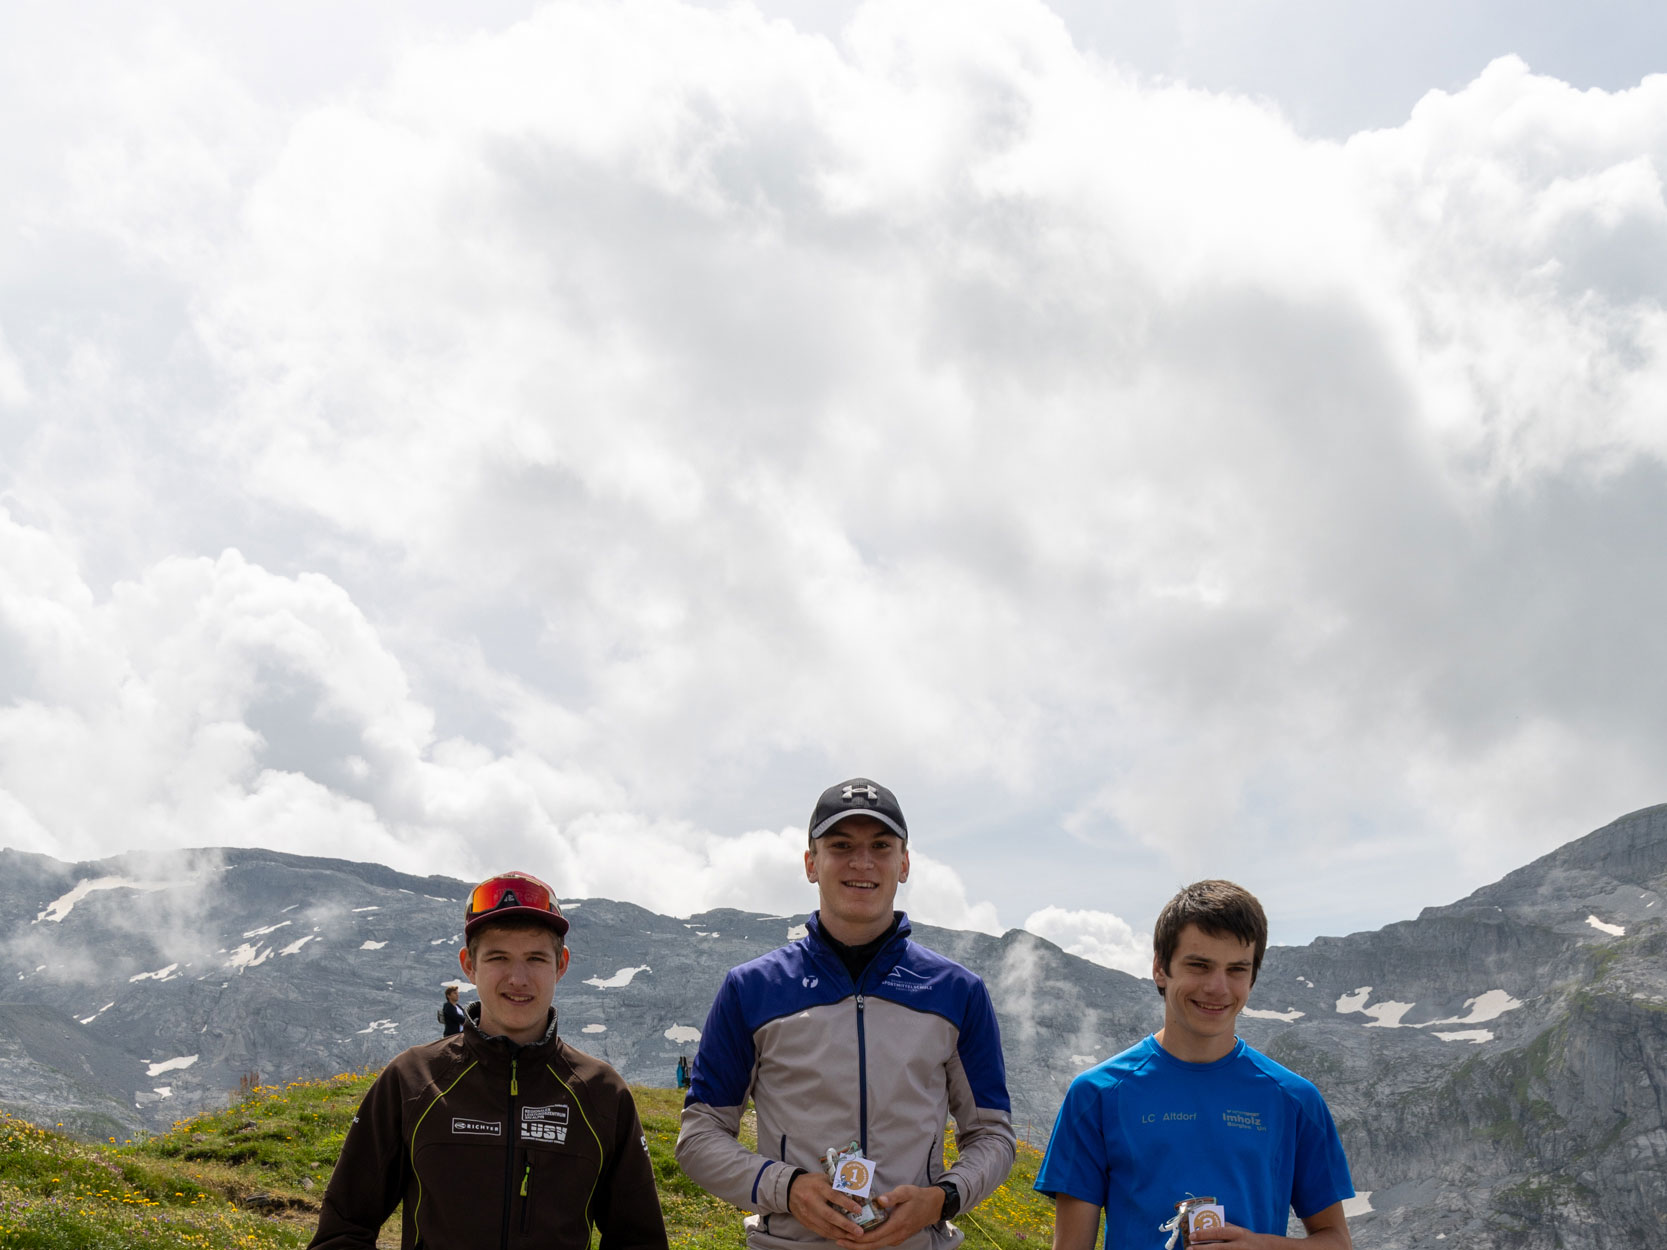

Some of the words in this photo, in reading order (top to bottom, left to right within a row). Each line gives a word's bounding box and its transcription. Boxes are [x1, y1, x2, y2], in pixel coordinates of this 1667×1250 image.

[1142, 1113, 1156, 1124] LC
[1163, 1112, 1197, 1121] Altdorf
[1222, 1112, 1261, 1126] Imholz
[466, 1124, 499, 1132] RICHTER
[521, 1123, 567, 1141] LUSV
[850, 1168, 858, 1183] 1
[1202, 1217, 1213, 1230] 2
